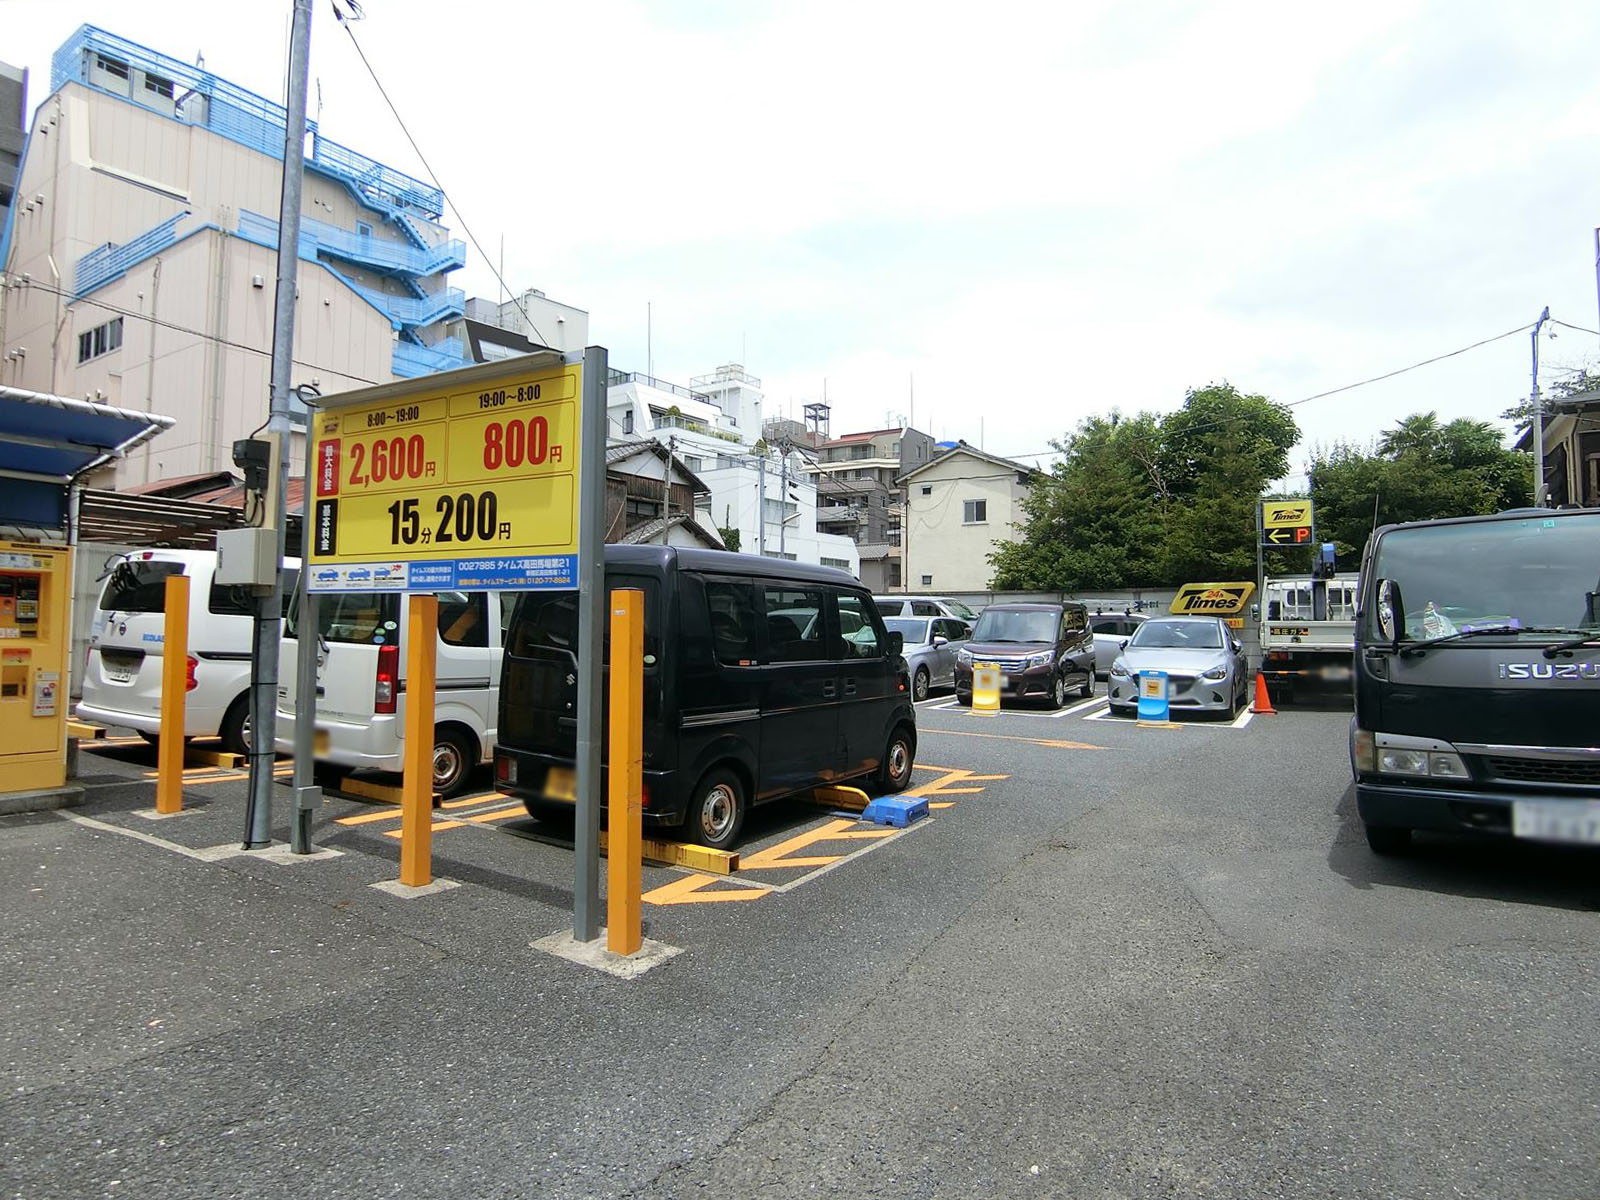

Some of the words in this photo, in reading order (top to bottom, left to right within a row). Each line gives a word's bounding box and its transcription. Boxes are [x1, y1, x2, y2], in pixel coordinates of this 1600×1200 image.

[1272, 509, 1304, 521] Times
[1297, 528, 1308, 542] P
[1181, 590, 1243, 610] Times
[1499, 663, 1600, 679] ISUZU
